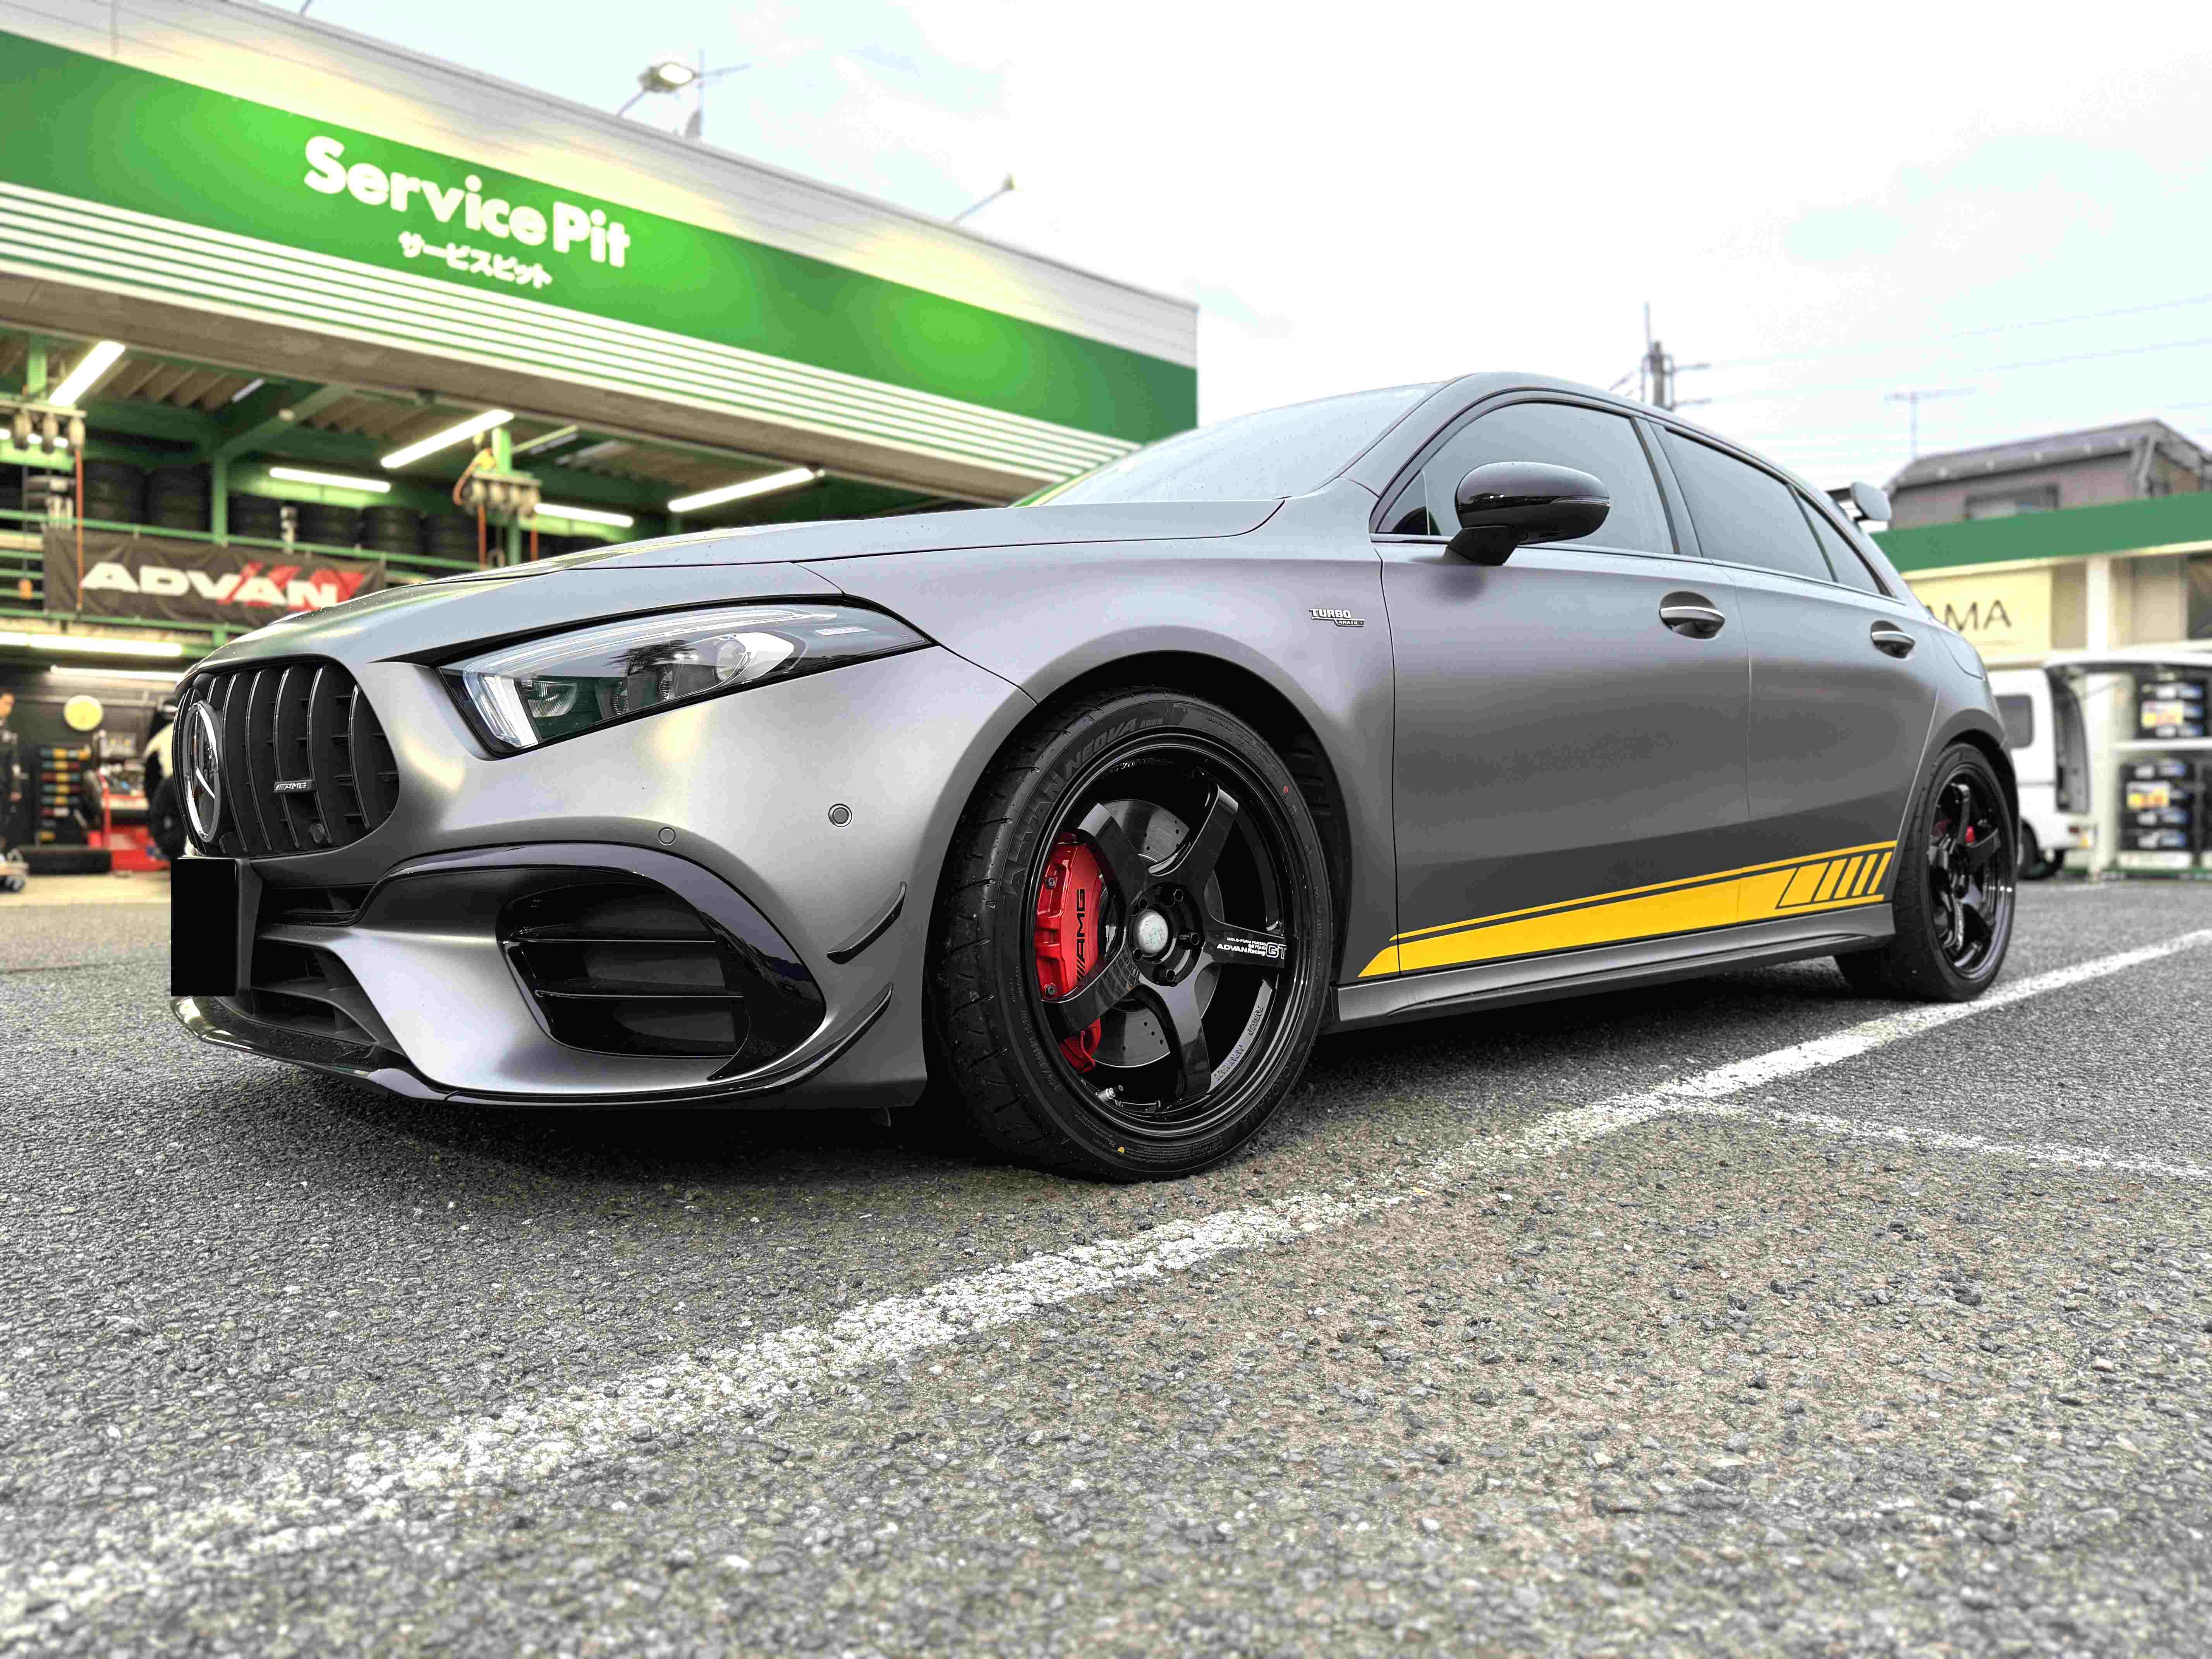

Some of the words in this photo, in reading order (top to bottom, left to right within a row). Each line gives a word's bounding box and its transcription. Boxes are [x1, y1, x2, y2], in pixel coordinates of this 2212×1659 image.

[304, 136, 547, 246] Service
[553, 201, 631, 268] Pit
[398, 230, 553, 290] サービスピット
[79, 562, 338, 608] ADVAN
[1309, 608, 1351, 618] TURBO
[1076, 889, 1085, 961] AMG
[1217, 944, 1247, 953] ADVAN
[1266, 942, 1287, 960] GT
